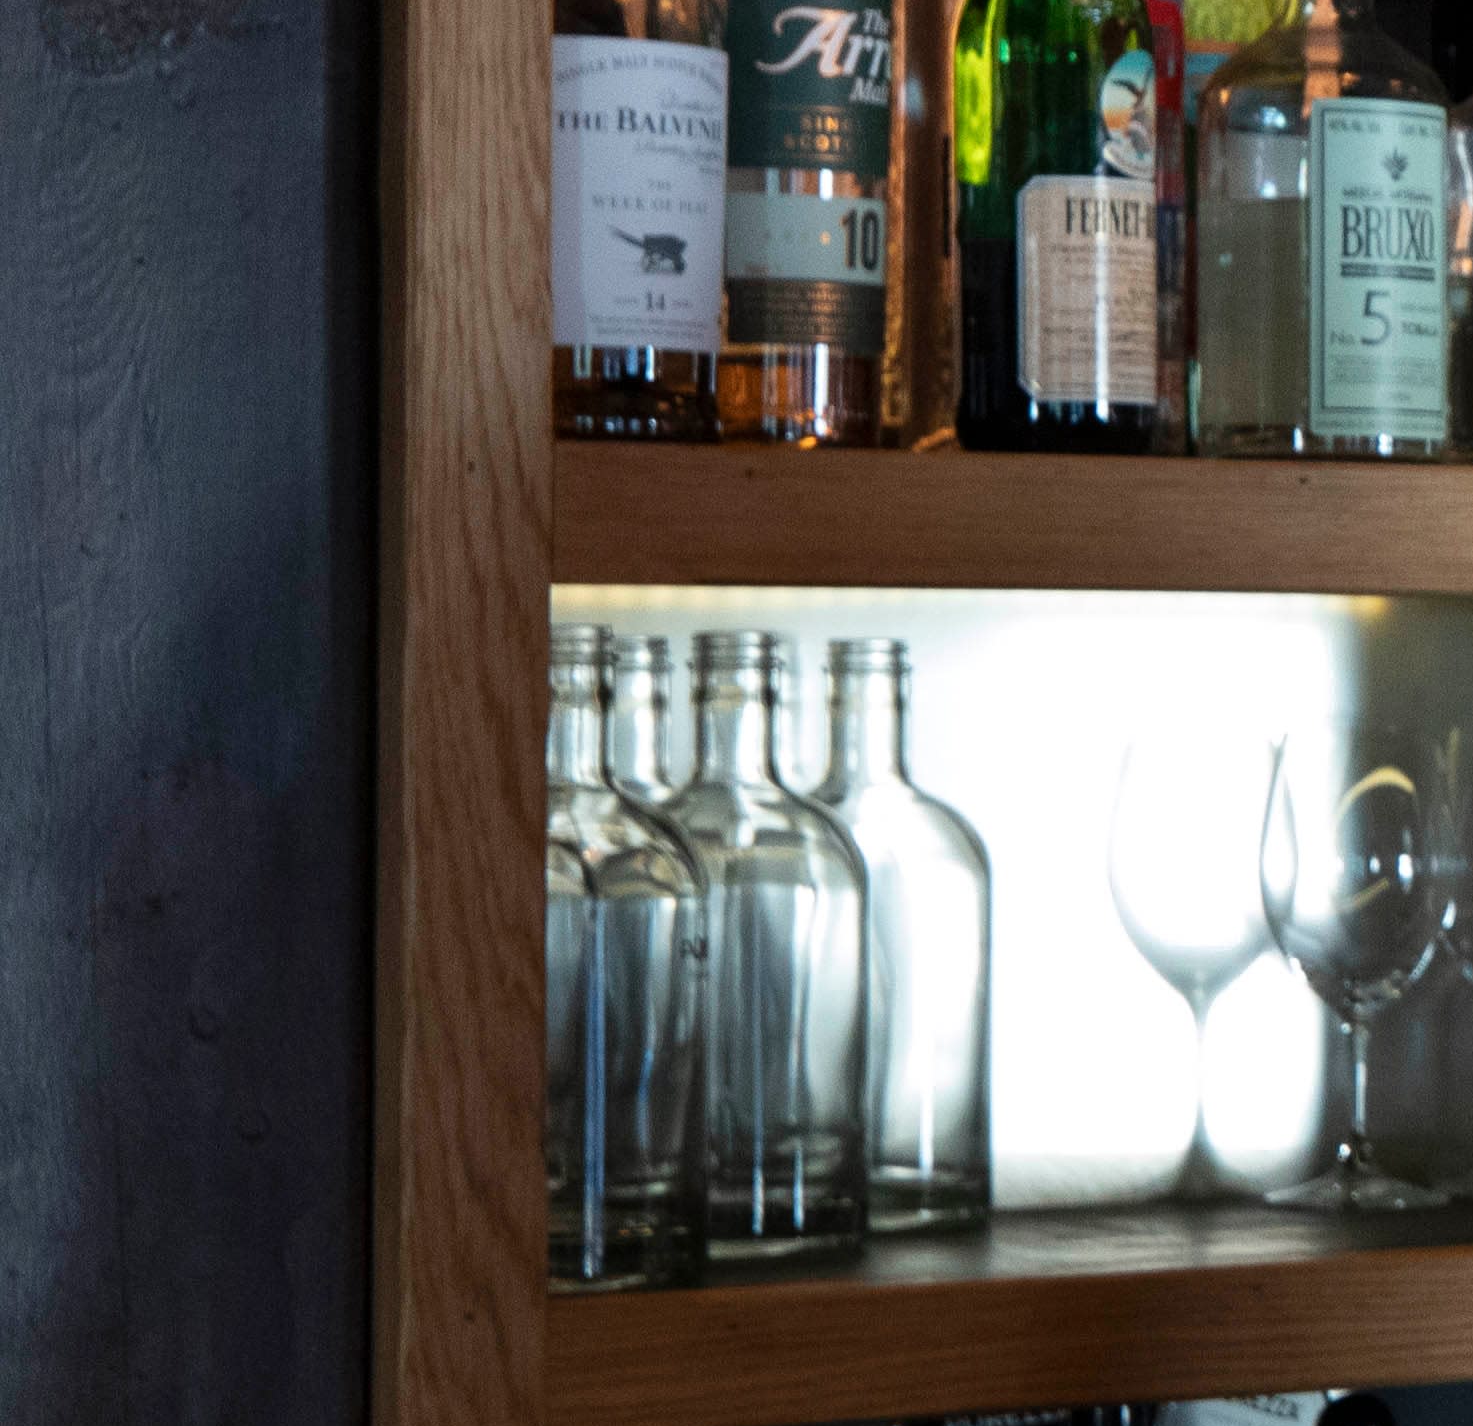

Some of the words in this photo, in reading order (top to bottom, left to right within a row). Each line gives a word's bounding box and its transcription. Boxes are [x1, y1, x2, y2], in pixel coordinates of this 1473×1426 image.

[557, 109, 609, 131] THE
[842, 208, 880, 272] 10
[1341, 204, 1435, 262] BRUXO
[1361, 290, 1392, 346] 5
